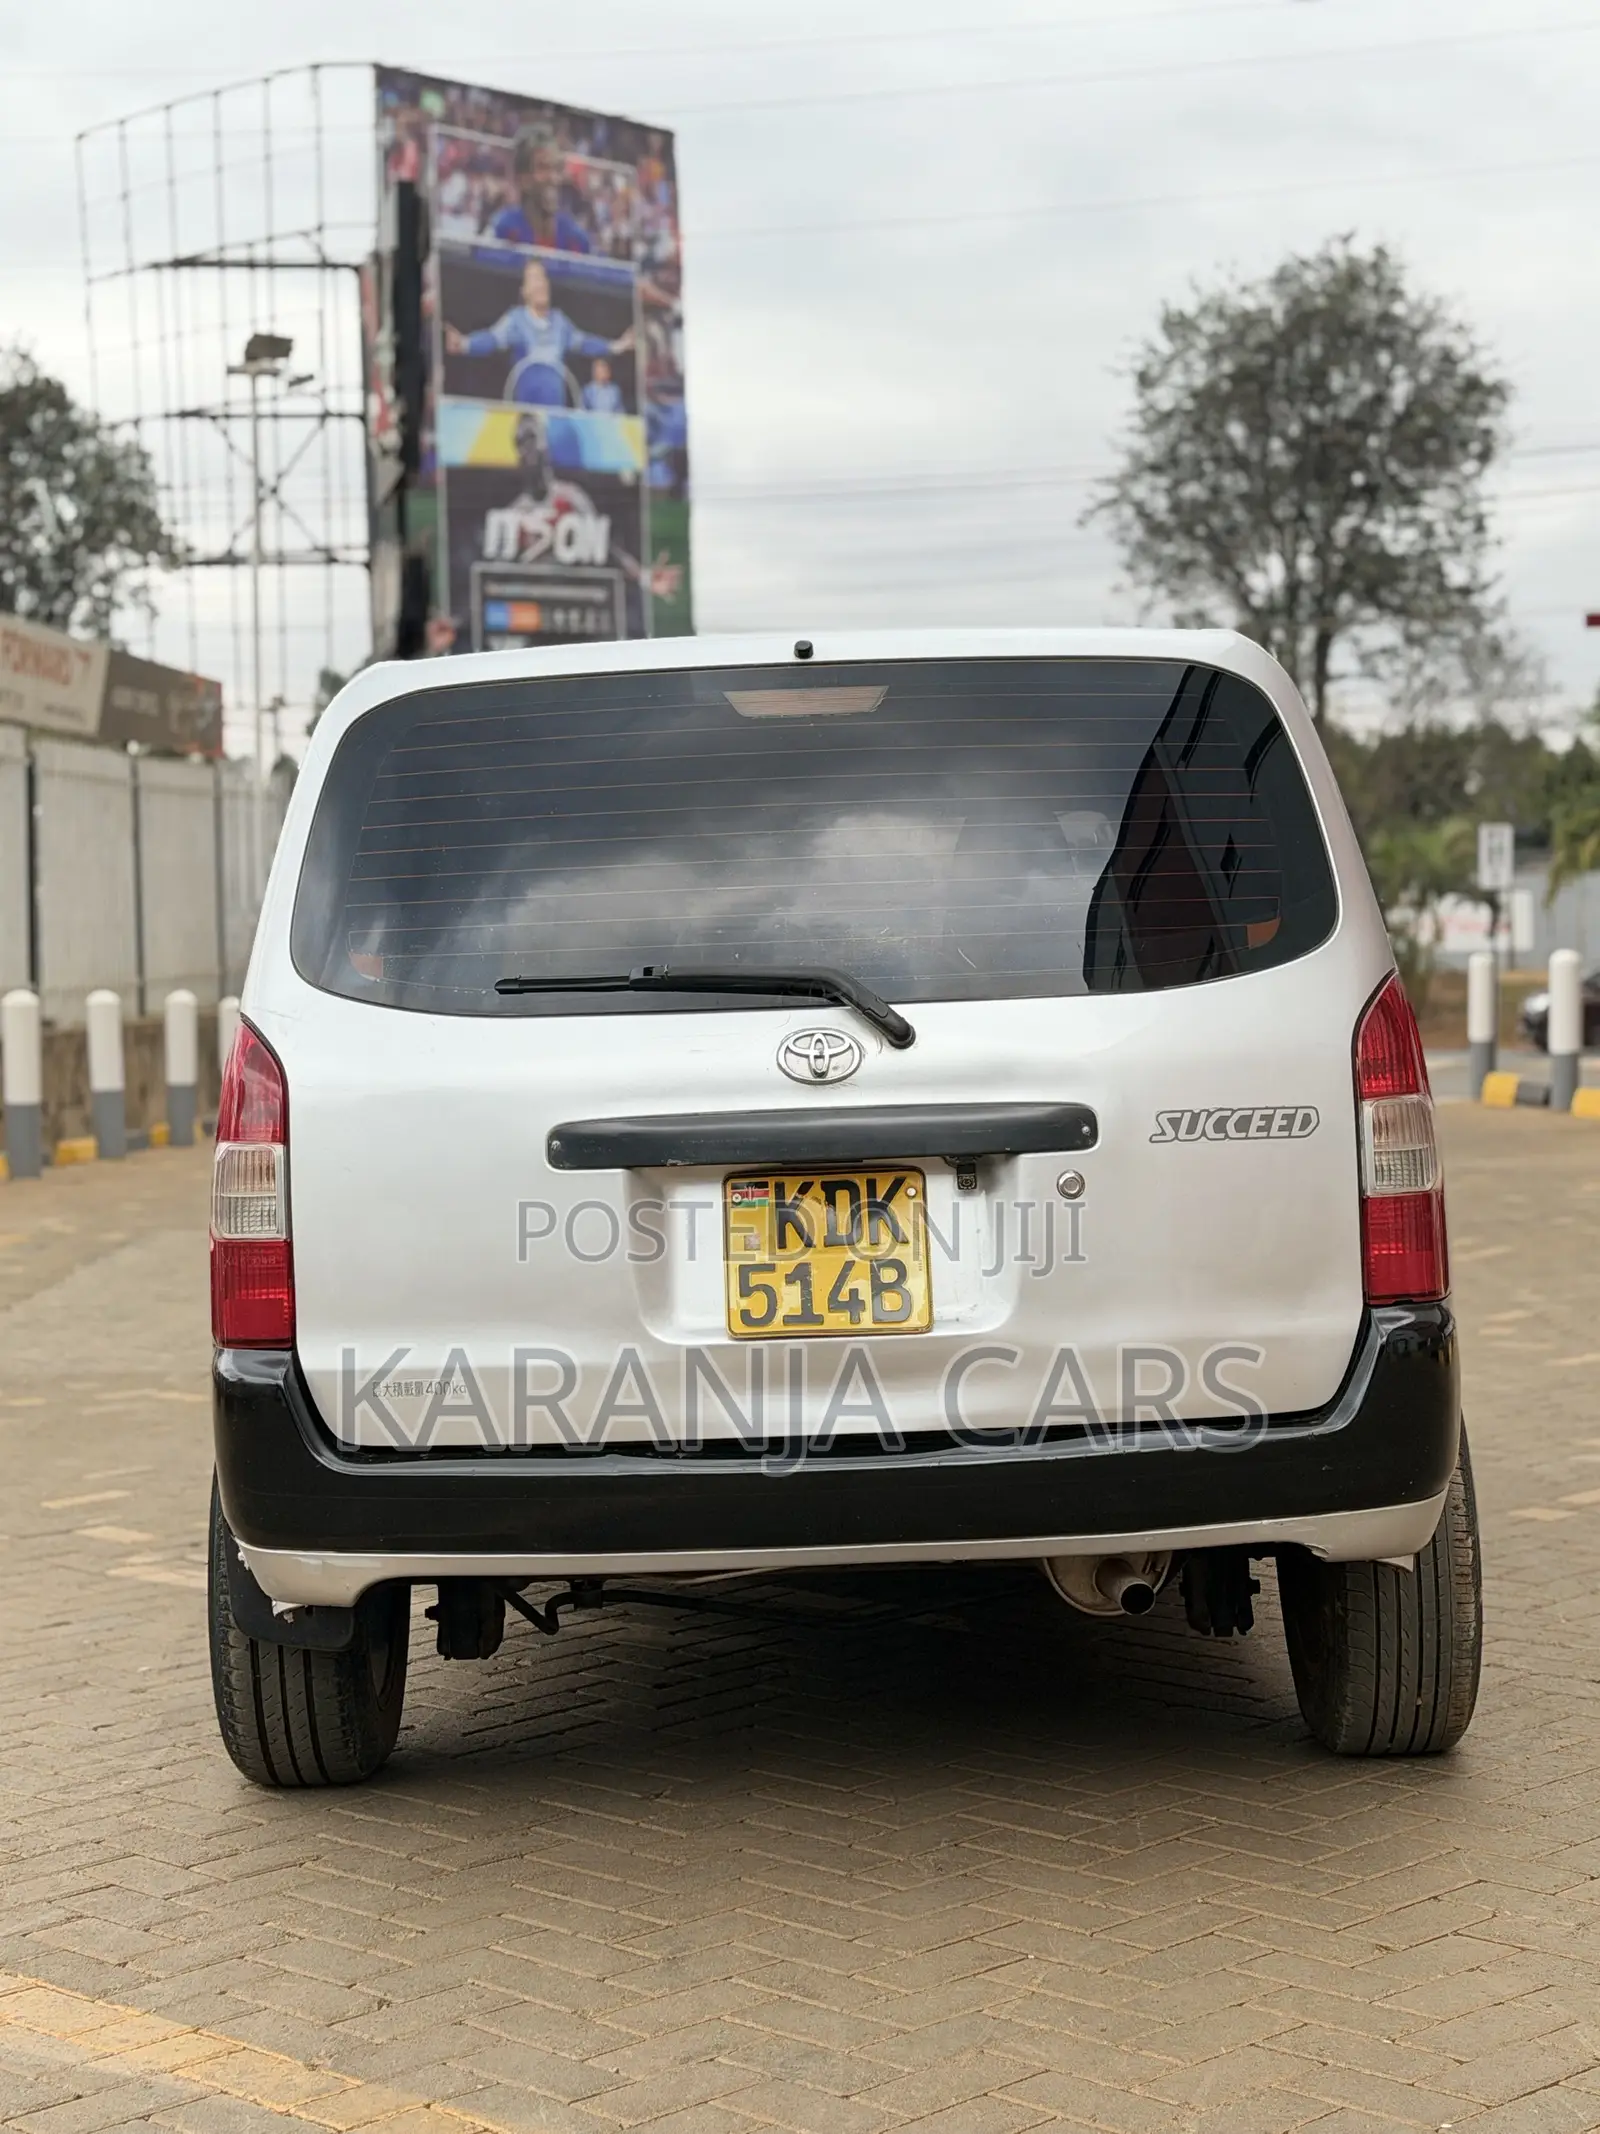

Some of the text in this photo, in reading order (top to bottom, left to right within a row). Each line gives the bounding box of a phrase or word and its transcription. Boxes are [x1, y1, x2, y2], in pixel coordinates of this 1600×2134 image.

[1149, 1106, 1320, 1143] SUCCEED
[774, 1176, 910, 1249] KDK
[738, 1258, 913, 1327] 514B
